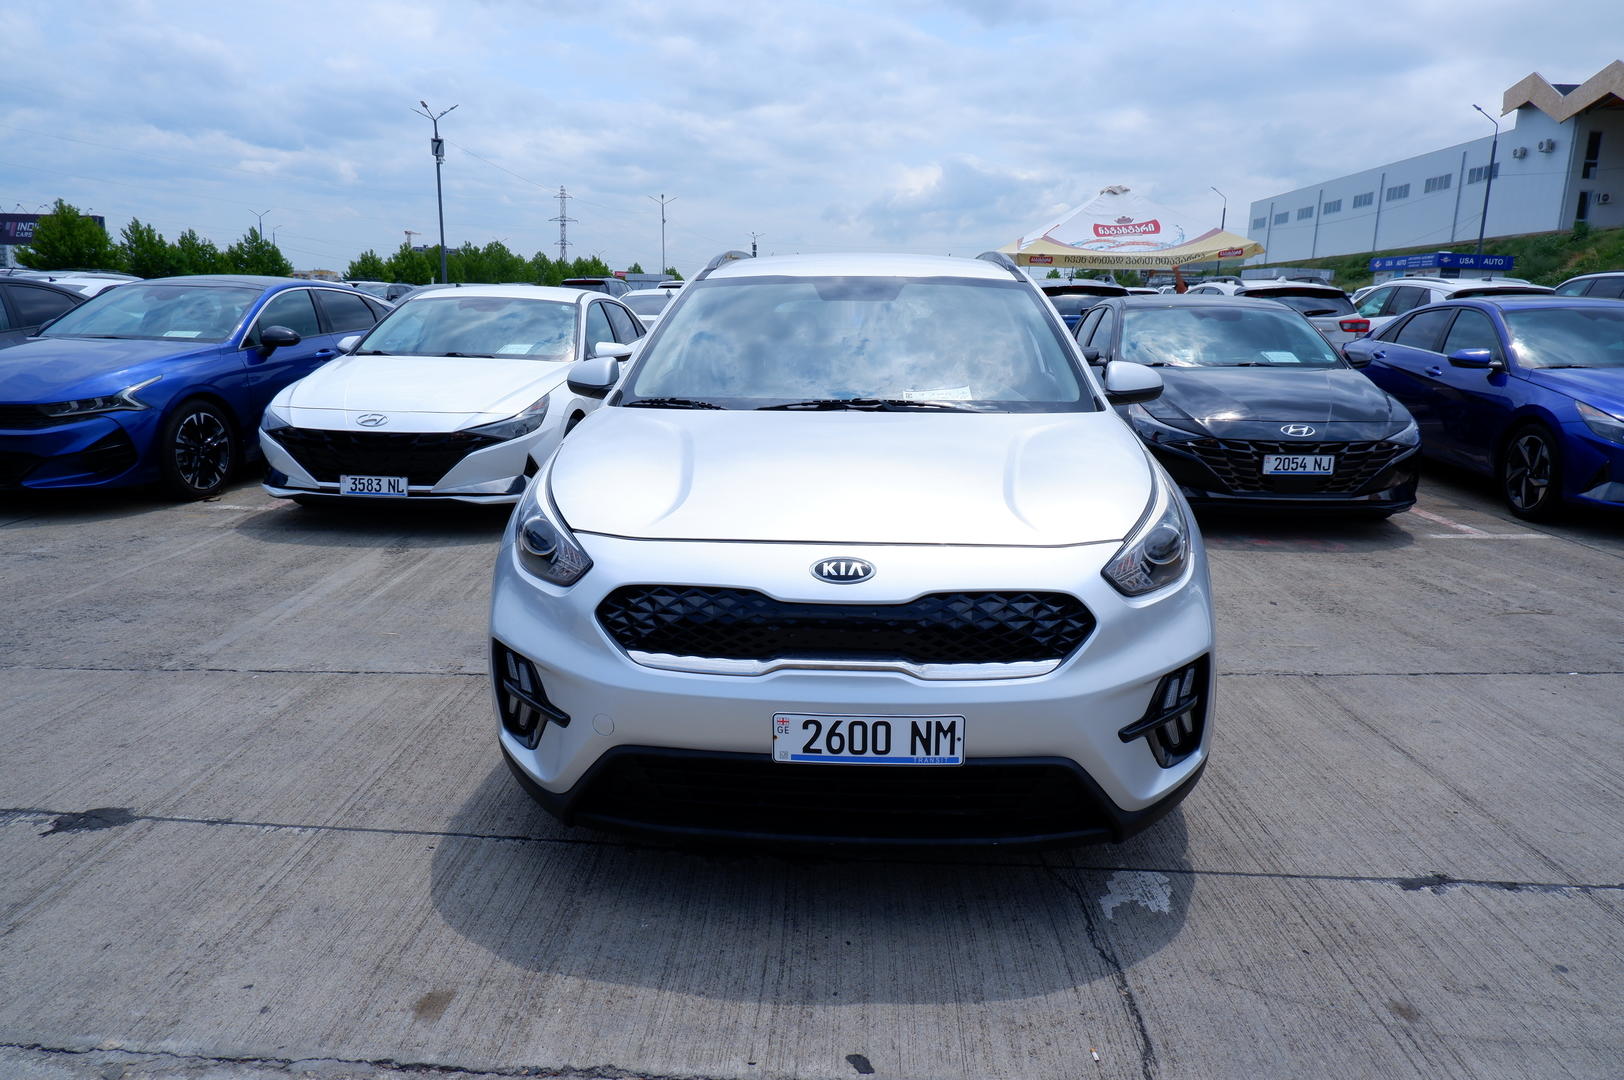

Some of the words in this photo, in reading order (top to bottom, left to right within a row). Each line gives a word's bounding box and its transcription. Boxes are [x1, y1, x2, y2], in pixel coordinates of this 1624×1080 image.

[1459, 257, 1474, 265] USA
[1483, 257, 1504, 266] AUTO
[1273, 457, 1307, 471] 2054
[1313, 457, 1332, 471] NJ
[350, 477, 382, 493] 3583
[387, 478, 405, 493] NL
[822, 561, 865, 577] KIA
[777, 725, 790, 735] GE
[802, 719, 892, 756] 2600
[910, 720, 957, 756] NM
[913, 756, 949, 764] TRANSIT
